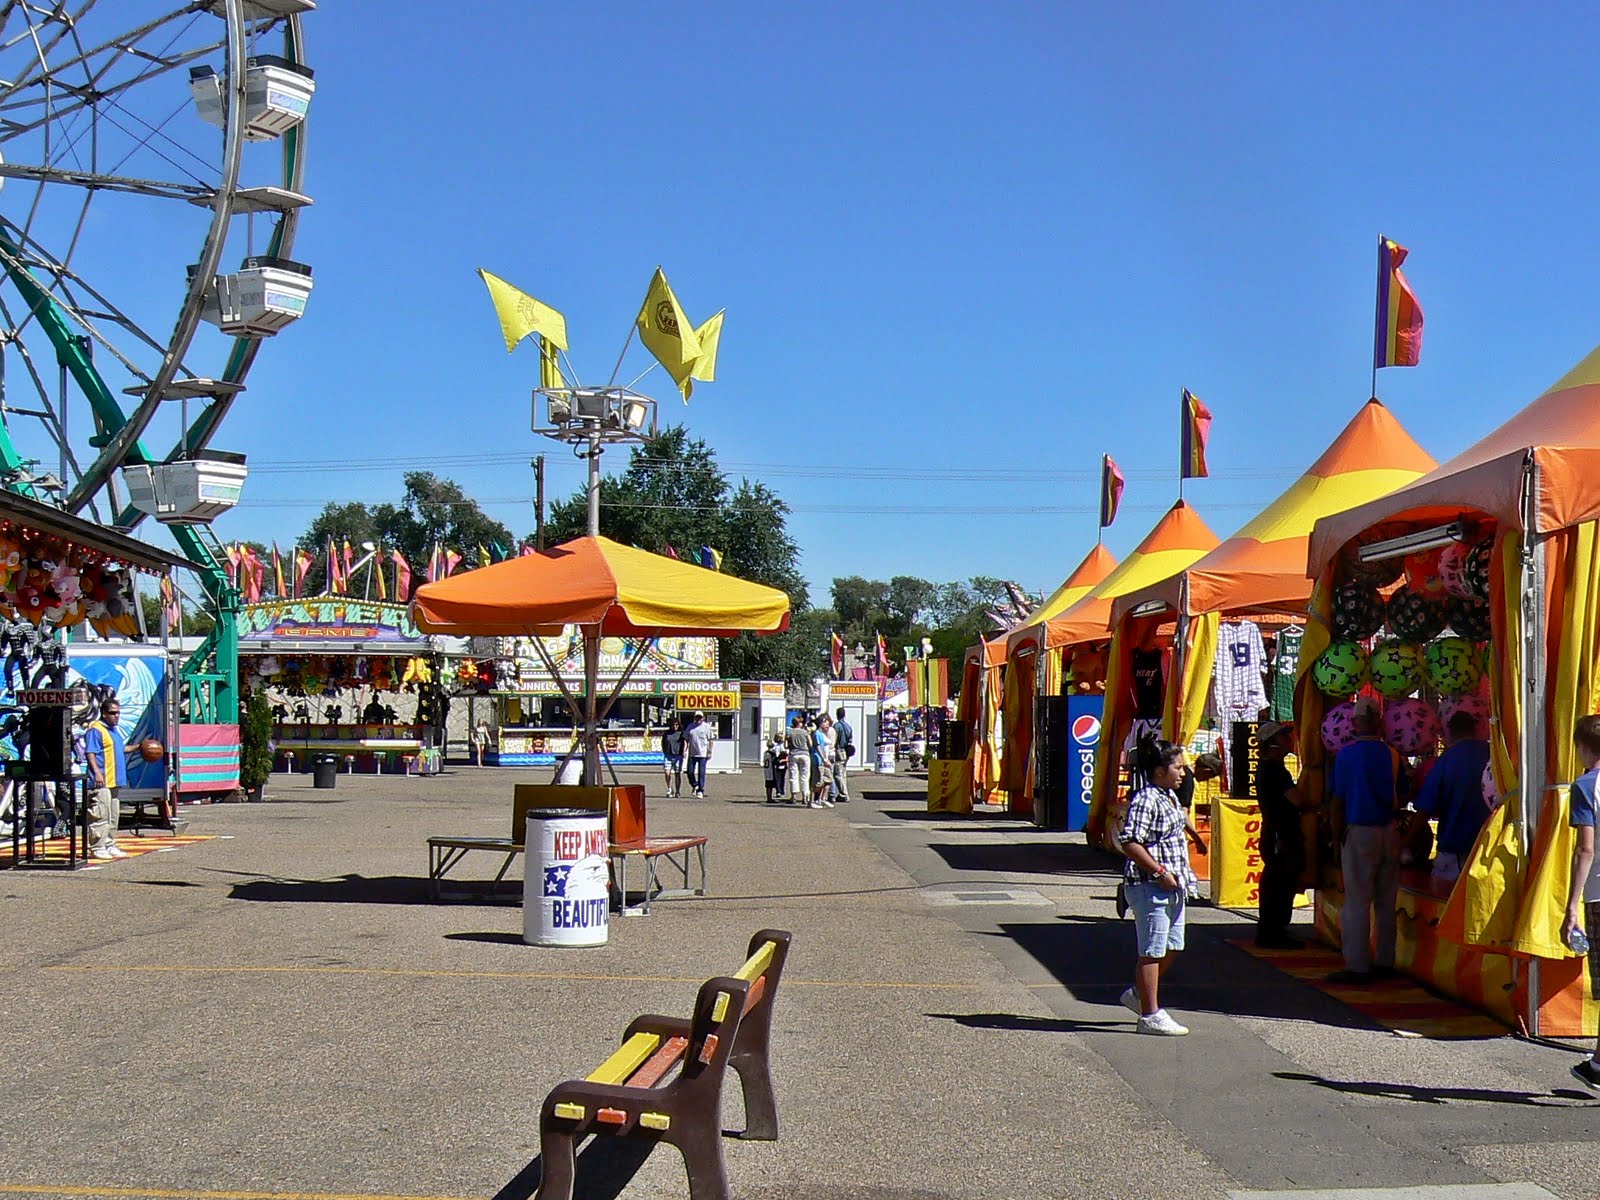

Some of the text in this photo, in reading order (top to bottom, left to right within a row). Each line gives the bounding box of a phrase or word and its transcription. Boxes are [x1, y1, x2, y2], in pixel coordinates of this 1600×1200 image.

[248, 258, 258, 268] 5
[237, 602, 421, 638] WATER
[285, 627, 367, 637] GAME
[1136, 667, 1158, 677] HEAT
[552, 682, 580, 691] CKES
[596, 682, 653, 691] EMONADE
[663, 682, 692, 691] CORN
[695, 682, 724, 691] DOGS
[831, 685, 875, 694] ARMBANDS
[17, 691, 73, 704] TOKENS
[680, 694, 731, 708] TOKENS
[1248, 723, 1259, 796] TOKENS
[1078, 749, 1095, 804] pepsi
[554, 831, 581, 860] KEEP
[1244, 804, 1262, 901] TOKENS
